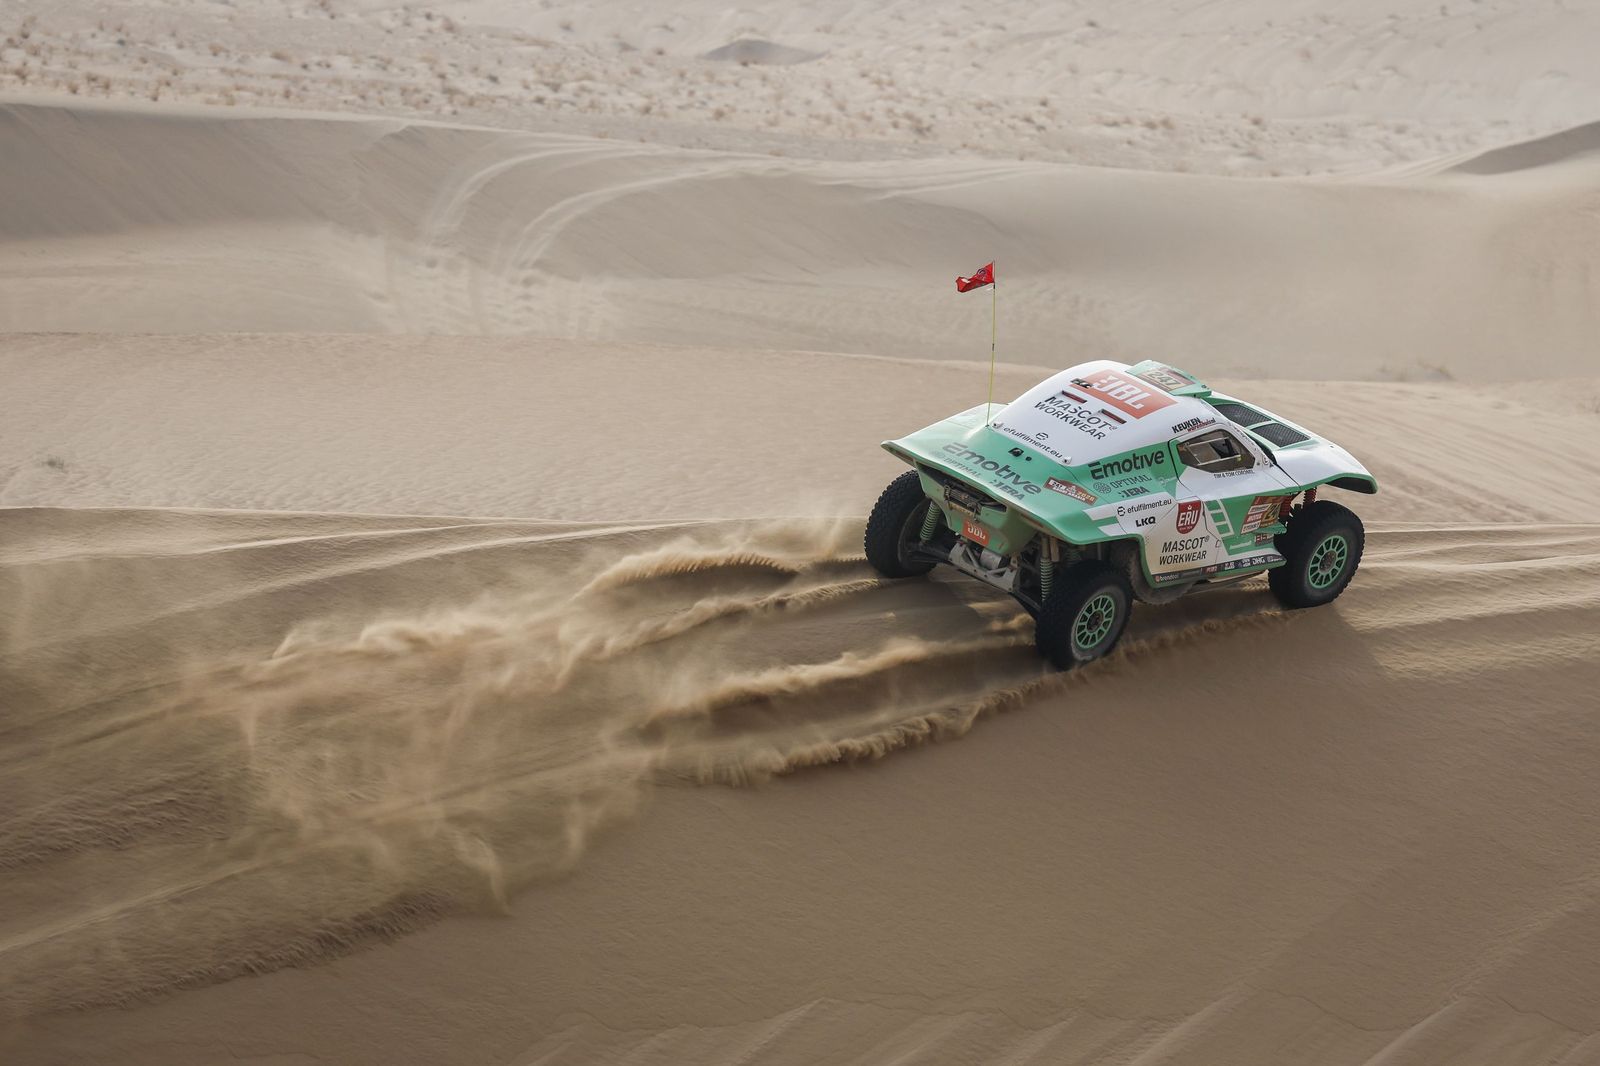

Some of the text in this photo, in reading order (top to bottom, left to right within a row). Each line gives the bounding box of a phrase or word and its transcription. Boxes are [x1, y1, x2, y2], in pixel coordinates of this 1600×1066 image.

[1147, 371, 1181, 386] 247
[1093, 377, 1151, 409] JBL
[1034, 401, 1106, 440] WORKWEAR
[1171, 417, 1200, 433] KEUKEN
[1003, 427, 1063, 458] efulfilment.eu
[942, 442, 1042, 494] Emotive
[1088, 450, 1165, 480] Emotive
[1110, 474, 1152, 489] OPTIMAL
[1127, 499, 1172, 514] efulfilment.eu
[1135, 516, 1156, 527] LKQ
[1178, 510, 1198, 526] ERU
[1159, 550, 1207, 565] WORKWEAR
